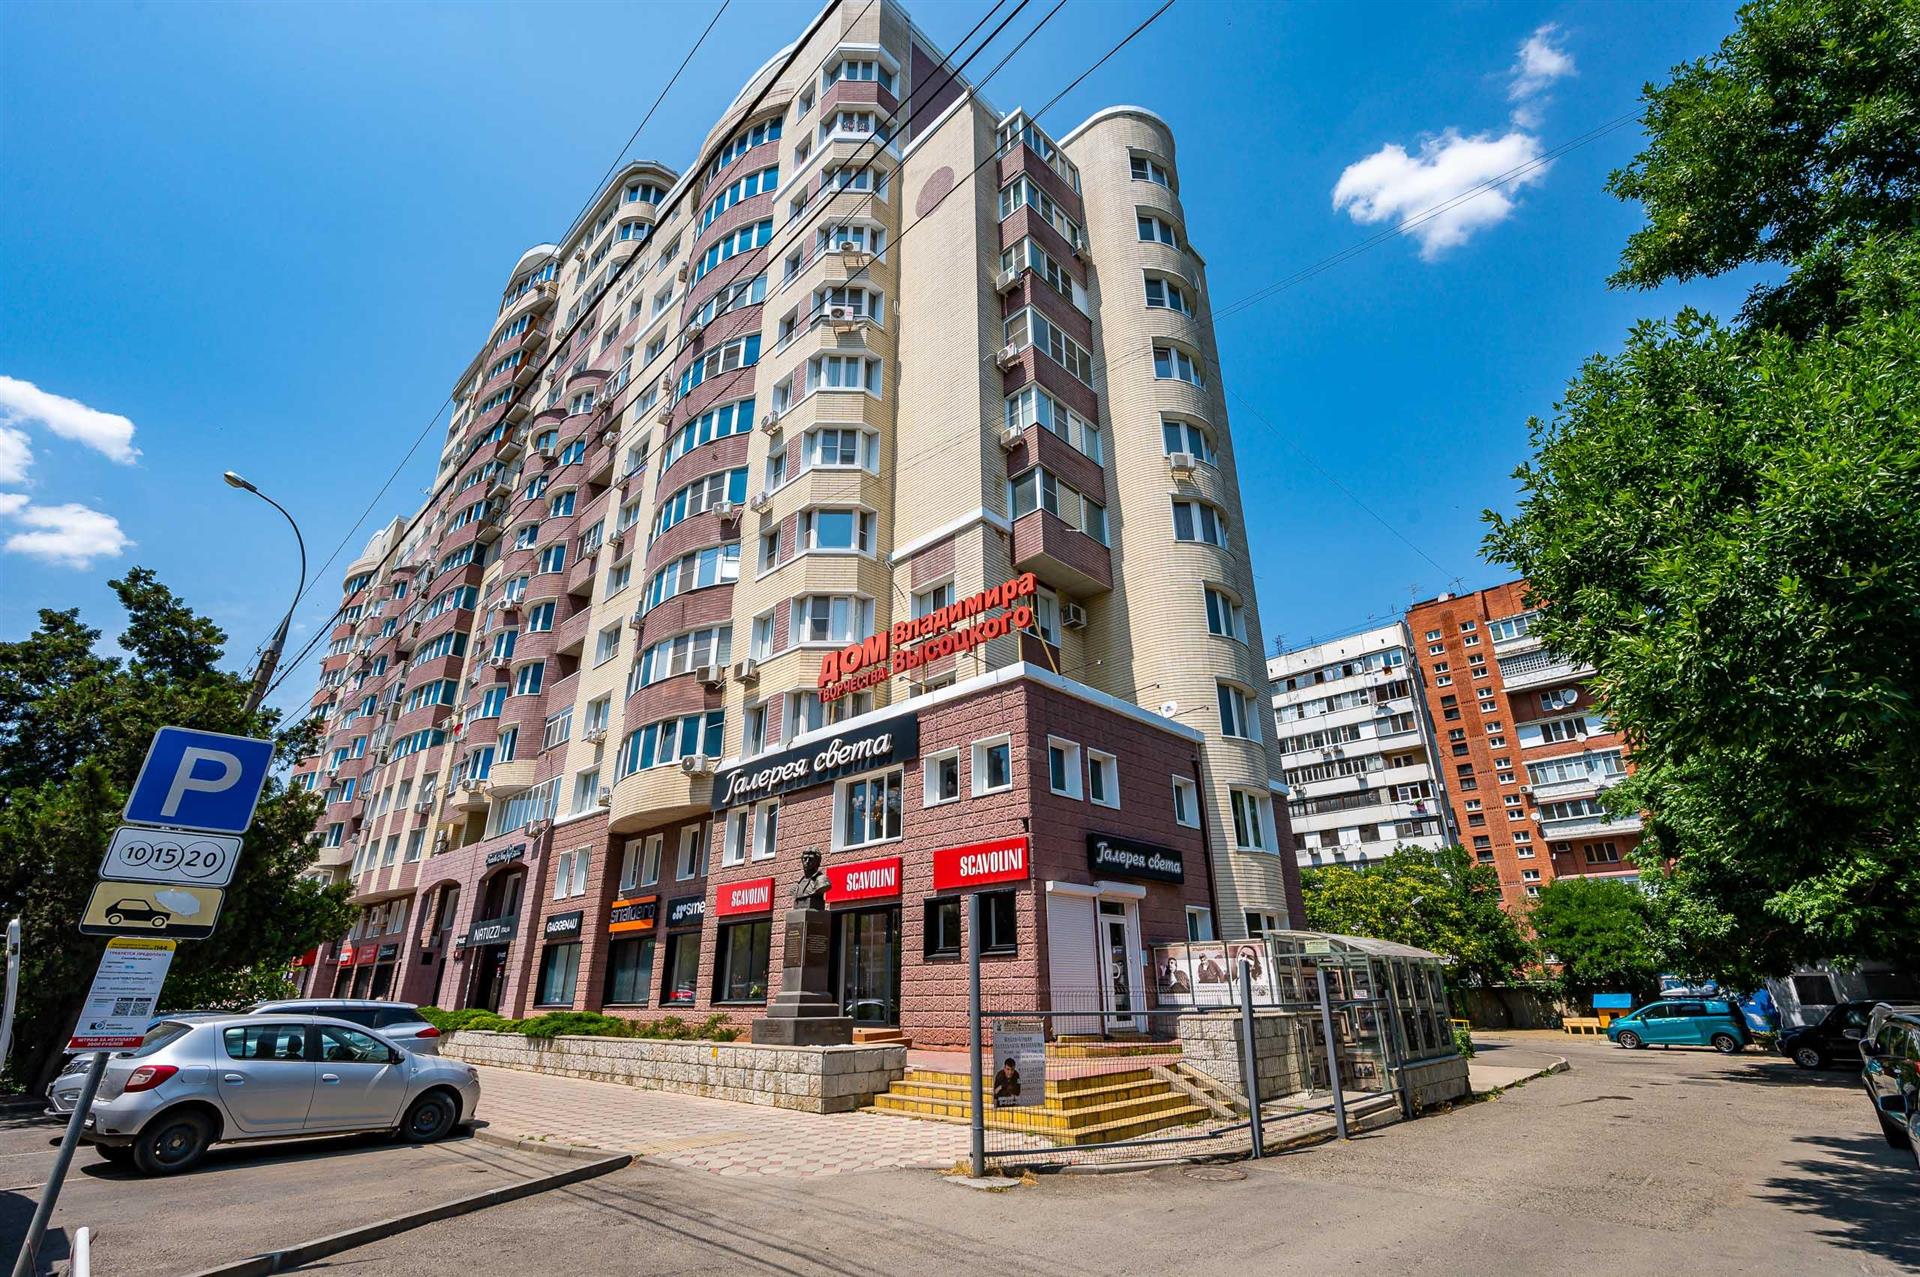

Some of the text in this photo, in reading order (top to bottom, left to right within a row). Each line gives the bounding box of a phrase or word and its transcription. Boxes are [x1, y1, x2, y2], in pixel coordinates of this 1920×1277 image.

[893, 572, 1038, 647] Владимира
[892, 605, 1035, 674] Высоцкого
[817, 666, 890, 704] ТВОРЧЕСТВА
[721, 733, 893, 804] Галерея света
[126, 846, 217, 868] 10 15 20
[959, 847, 1023, 877] SCAVOLINI
[1096, 841, 1182, 873] Галерея света
[846, 866, 896, 892] SCAVOLINI
[685, 900, 706, 916] sme
[730, 886, 769, 907] SCAVOLINI
[473, 925, 501, 941] NATUZZI
